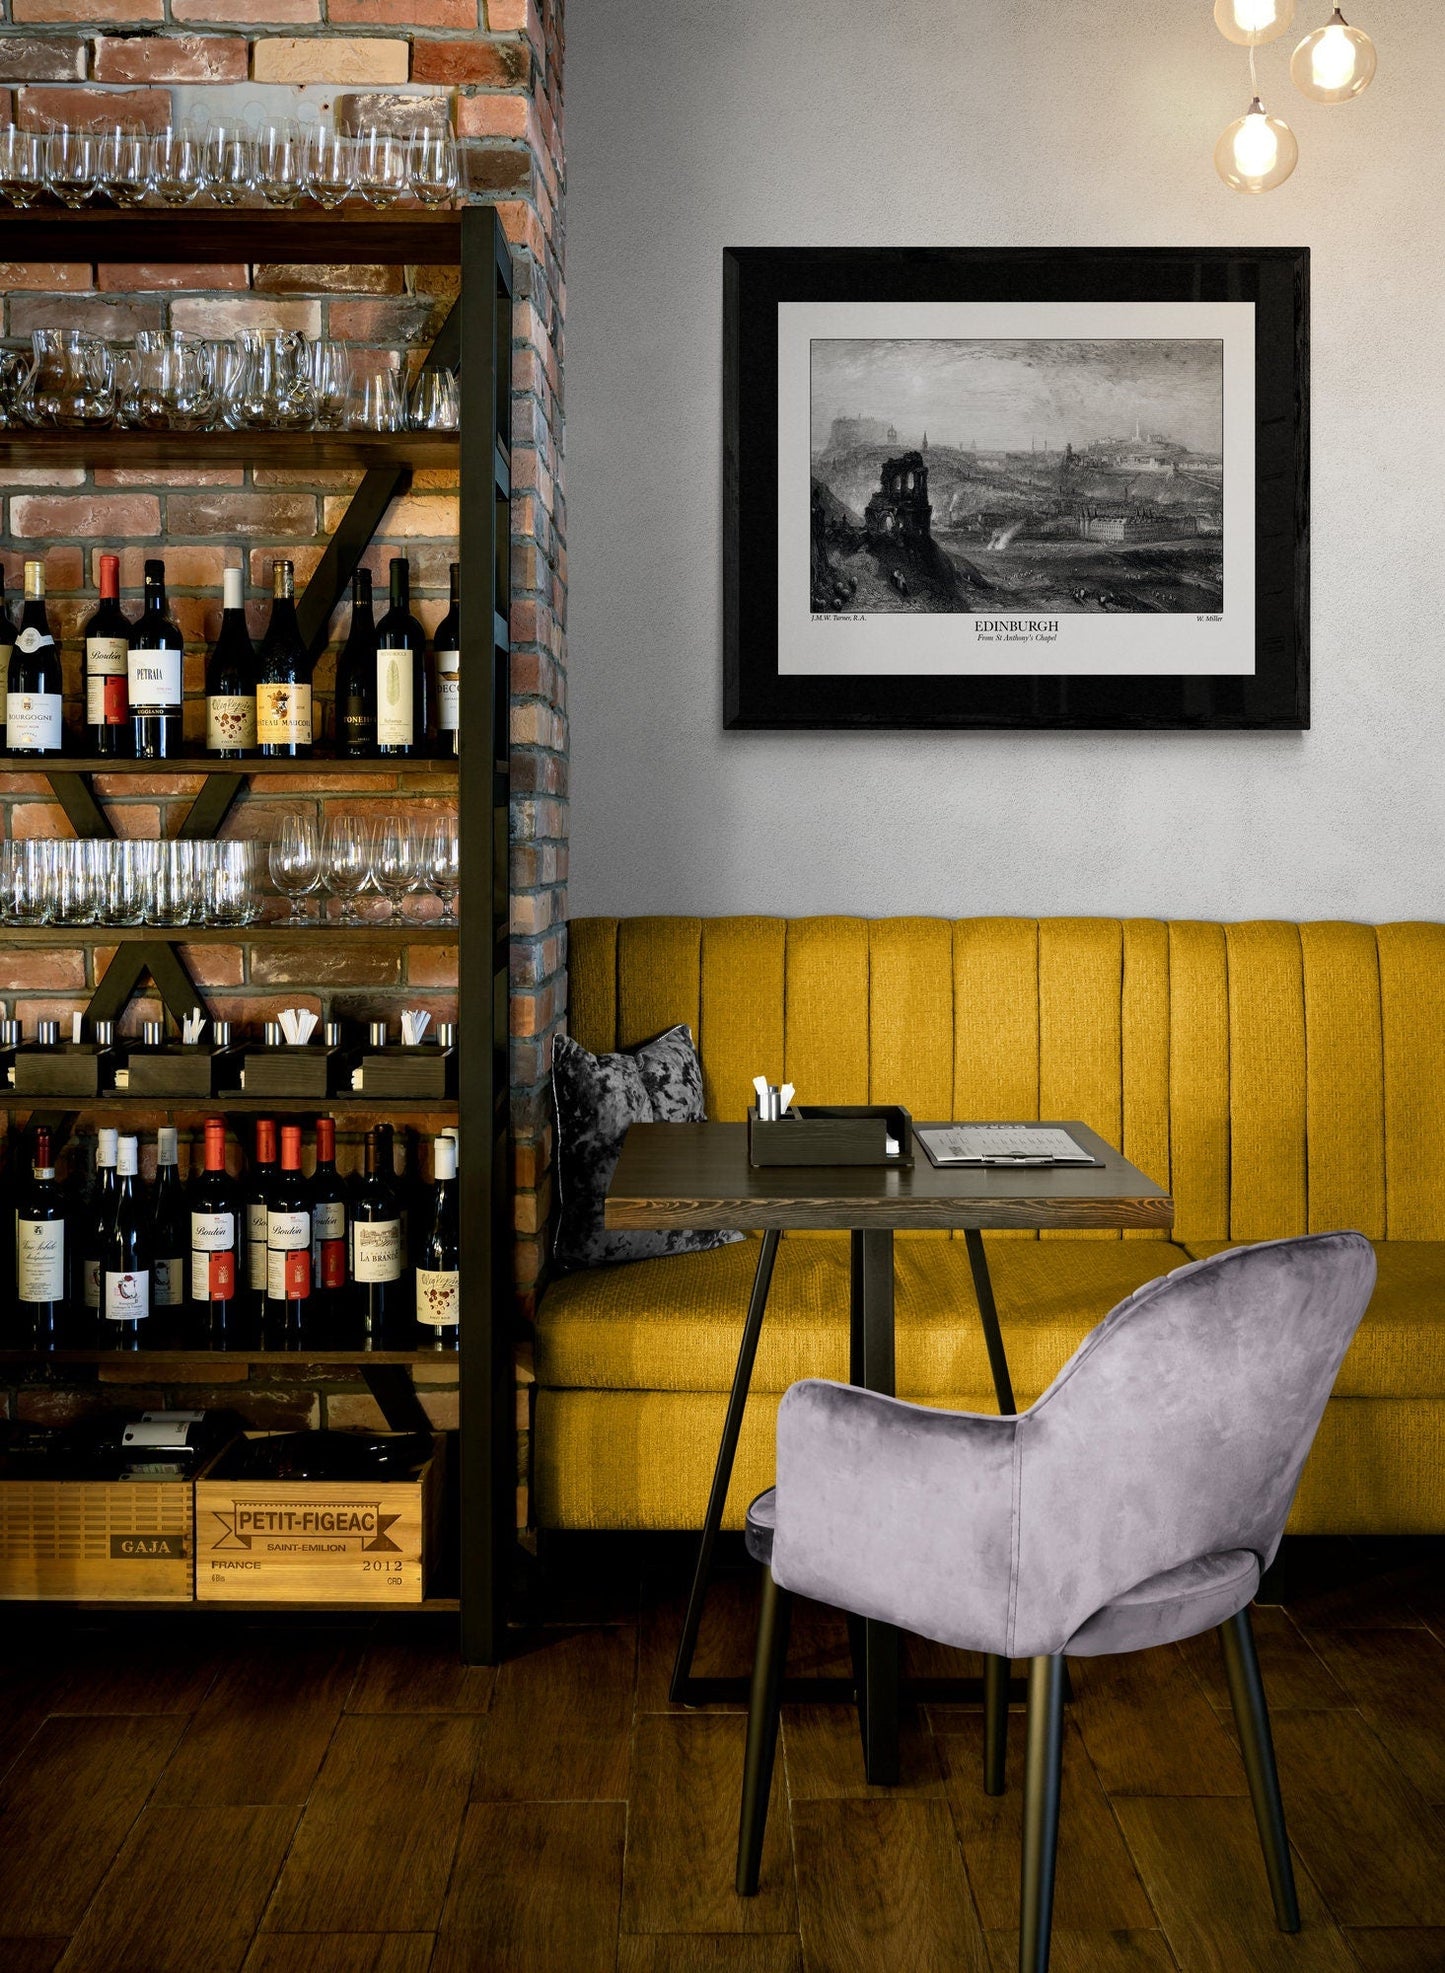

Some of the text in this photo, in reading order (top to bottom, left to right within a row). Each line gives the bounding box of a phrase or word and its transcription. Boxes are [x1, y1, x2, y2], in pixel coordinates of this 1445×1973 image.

[975, 621, 1059, 631] EDINBURGH
[1003, 634, 1033, 643] Anthony's
[1036, 634, 1057, 643] Chapel
[91, 650, 121, 660] Bordón
[8, 713, 52, 721] BOURGOGNE
[196, 1226, 226, 1236] Bordón
[272, 1225, 302, 1235] Bordón
[239, 1511, 375, 1531] PETIT-FIGEAC
[121, 1541, 171, 1553] GAJA
[267, 1543, 346, 1552] SAINT-EMILION
[211, 1560, 402, 1571] FRANCE 2012
